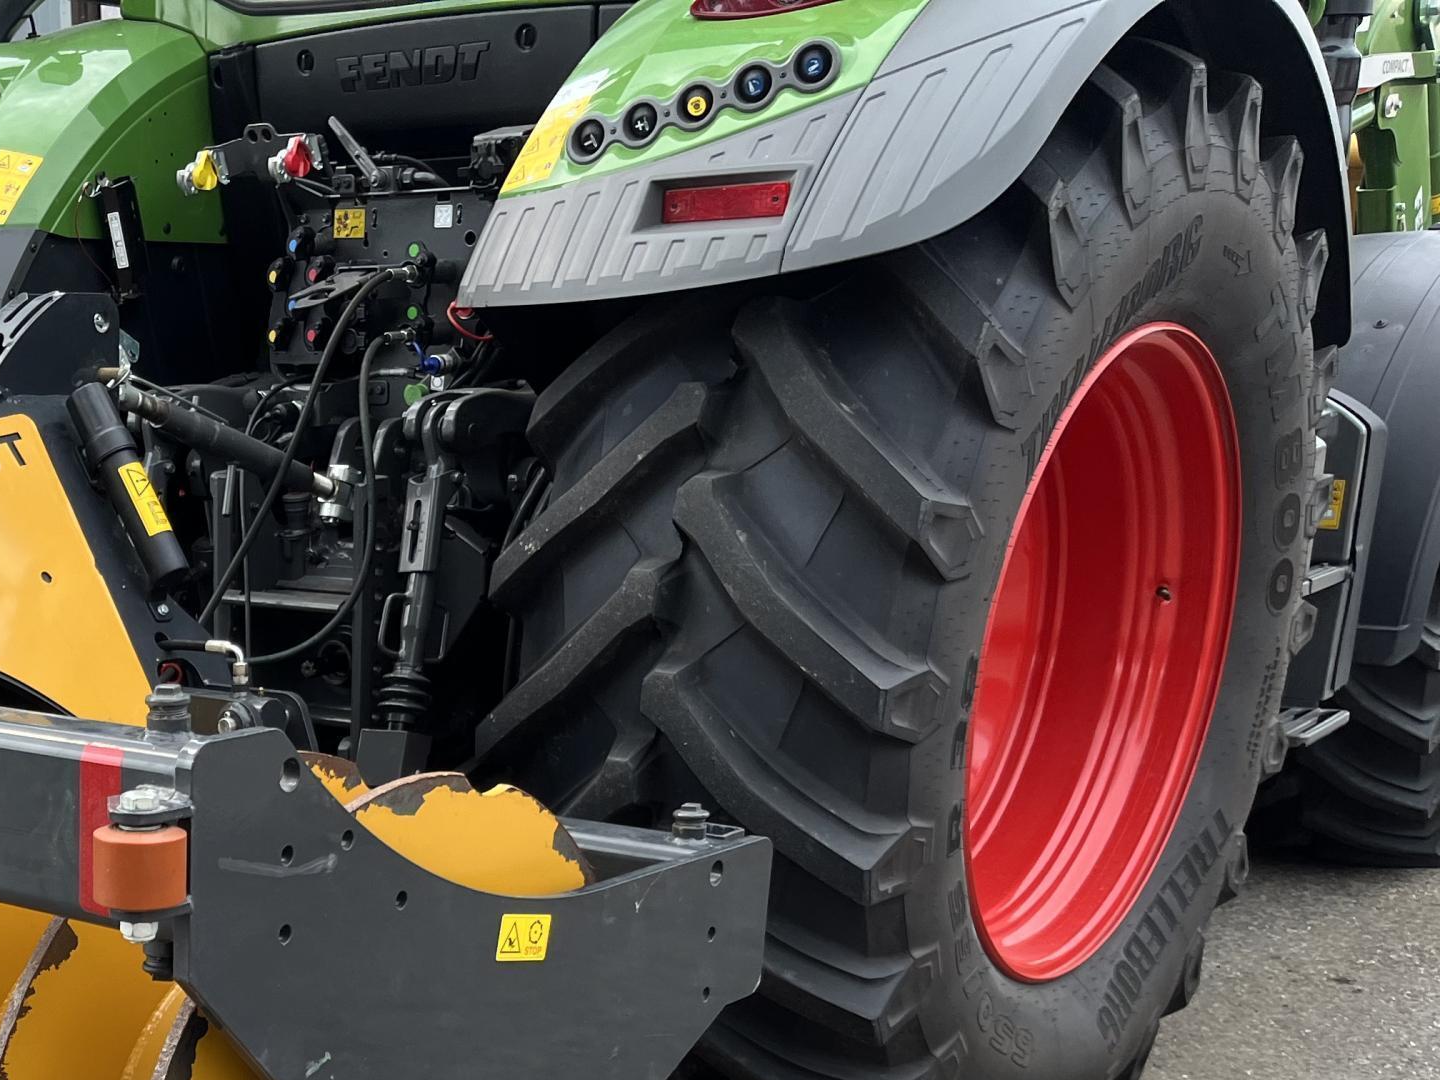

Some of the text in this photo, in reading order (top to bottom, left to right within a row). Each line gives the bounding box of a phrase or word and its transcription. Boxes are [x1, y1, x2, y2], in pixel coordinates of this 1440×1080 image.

[336, 40, 491, 93] FENDT
[1382, 58, 1410, 74] COMPACT
[1096, 808, 1235, 1053] TRELLEBORG
[524, 945, 542, 956] STOP
